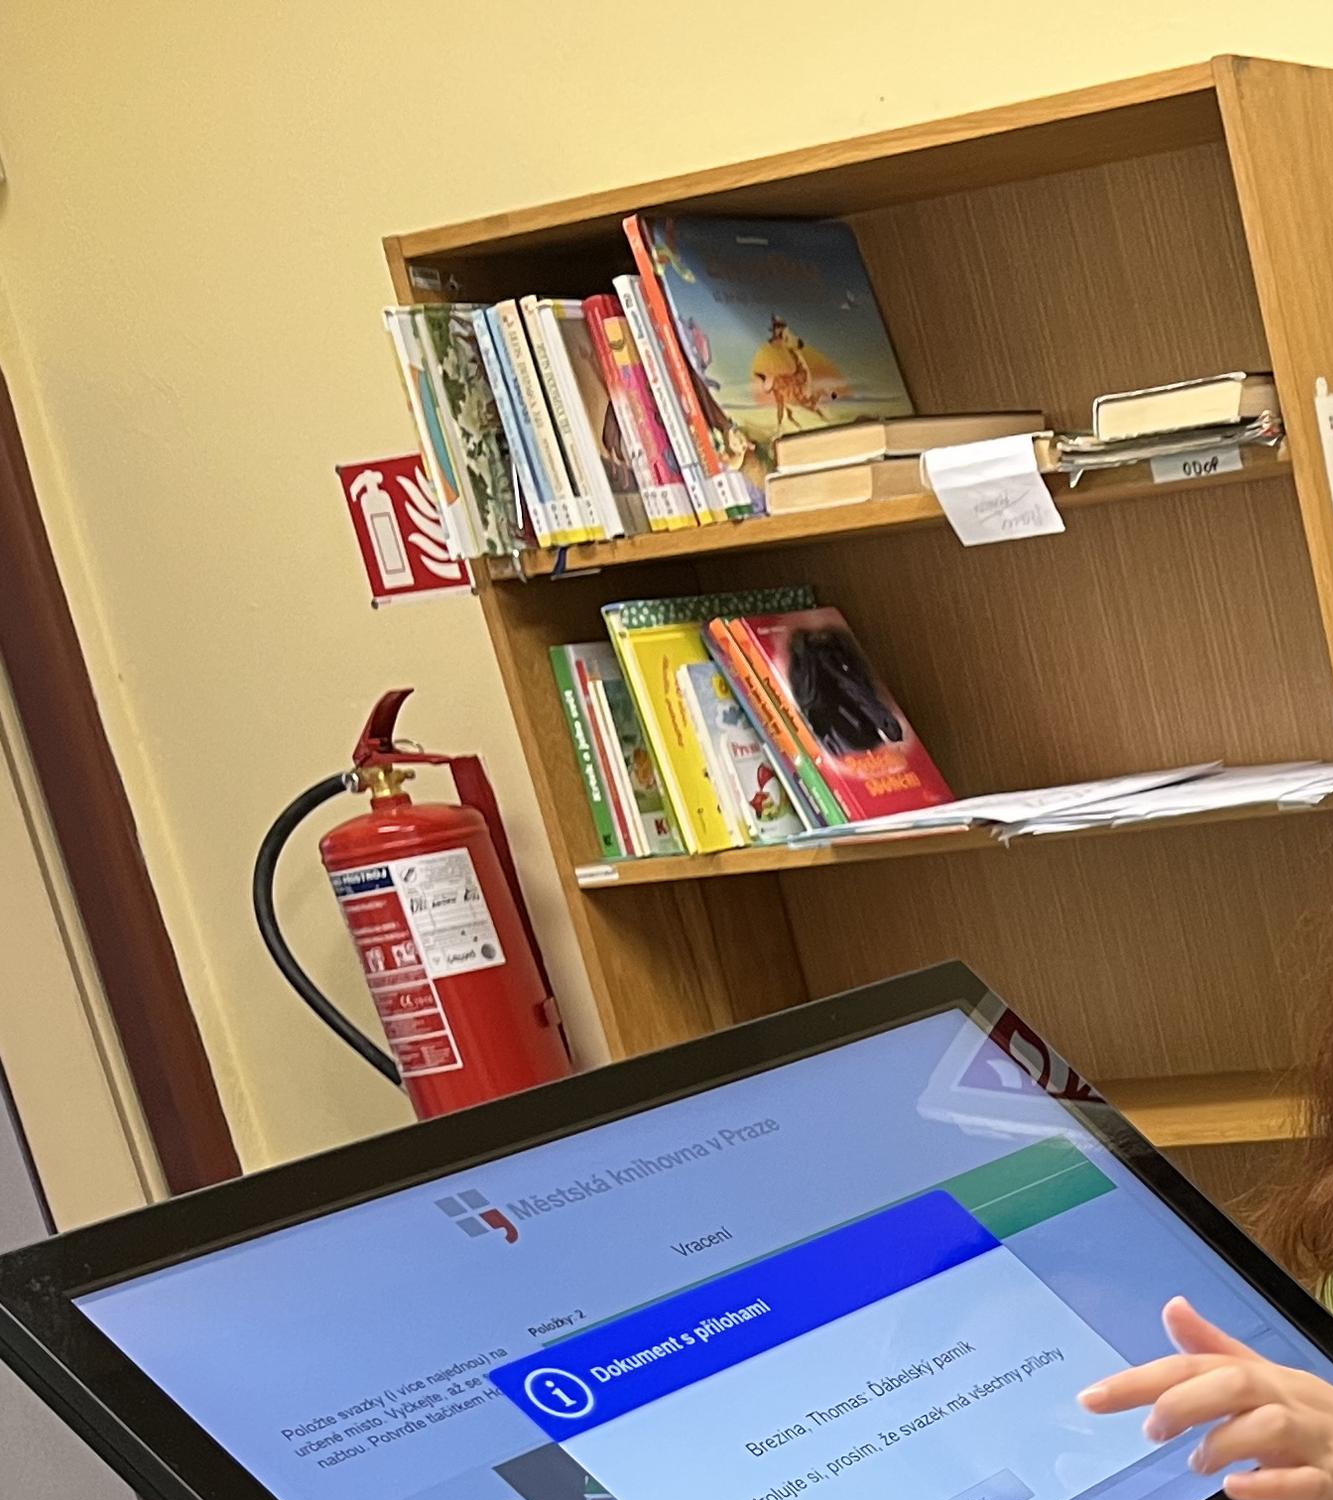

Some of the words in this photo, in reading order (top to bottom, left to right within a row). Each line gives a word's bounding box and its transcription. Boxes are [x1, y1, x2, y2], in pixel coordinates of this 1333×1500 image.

[506, 1171, 612, 1221] Městská
[605, 1143, 711, 1187] knihovna
[703, 1136, 724, 1152] v
[718, 1116, 781, 1148] Praze
[671, 1225, 734, 1259] Vracení
[576, 1308, 588, 1321] 2
[589, 1335, 685, 1384] Dokument
[680, 1332, 696, 1347] s
[693, 1297, 773, 1344] přílohami
[280, 1413, 338, 1442] Položte
[337, 1395, 386, 1426] svazky
[490, 1345, 509, 1365] na
[294, 1431, 345, 1459] určené
[446, 1377, 466, 1399] až
[463, 1372, 482, 1391] se
[744, 1420, 813, 1459] Brezina,
[804, 1390, 870, 1428] Thomas:
[866, 1357, 935, 1399] Ďábelský
[806, 1465, 830, 1486] si,
[826, 1438, 885, 1478] prosím,
[878, 1428, 901, 1447] že
[898, 1405, 949, 1437] svazek
[947, 1391, 972, 1414] má
[968, 1367, 1024, 1403] všechny
[1021, 1345, 1066, 1378] přílohy
